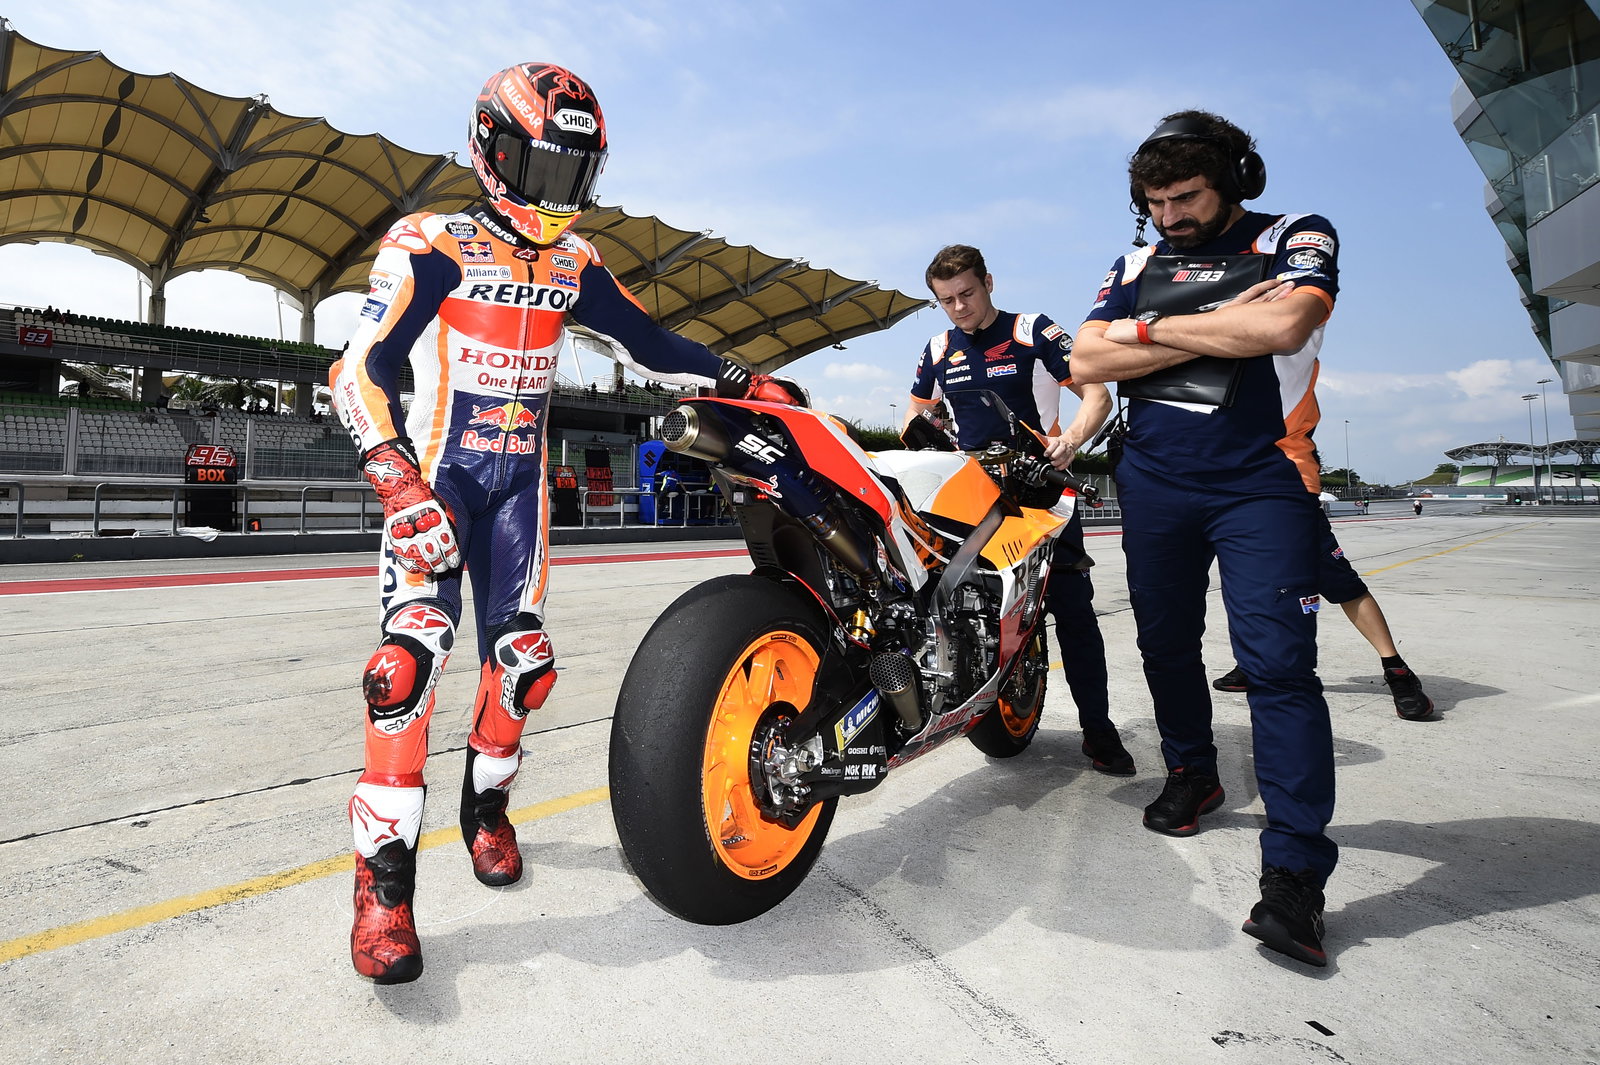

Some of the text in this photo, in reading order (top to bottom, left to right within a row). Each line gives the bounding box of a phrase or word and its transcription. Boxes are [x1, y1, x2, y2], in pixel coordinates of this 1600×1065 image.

[501, 78, 543, 129] PULL&BEAR
[562, 114, 593, 130] SHOEI
[531, 140, 562, 153] GIVES
[567, 147, 586, 158] YOU
[539, 199, 580, 212] PULL&BEAR
[480, 216, 518, 245] REPSOL
[1290, 236, 1333, 250] REPSOL
[554, 257, 575, 269] SHOEI
[466, 268, 498, 278] Allianz
[549, 270, 578, 288] HRC
[467, 283, 574, 311] REPSOL
[23, 331, 48, 343] 93
[457, 347, 557, 371] HONDA
[946, 364, 971, 375] REPSOL
[987, 364, 1018, 378] HRC
[477, 372, 508, 388] One
[343, 381, 356, 408] Satu
[460, 430, 536, 455] Red Bull
[738, 433, 786, 463] SC
[734, 444, 773, 465] PROJECT
[197, 468, 226, 482] BOX
[251, 521, 260, 531] 1
[844, 764, 861, 776] NGK
[862, 763, 877, 776] RK
